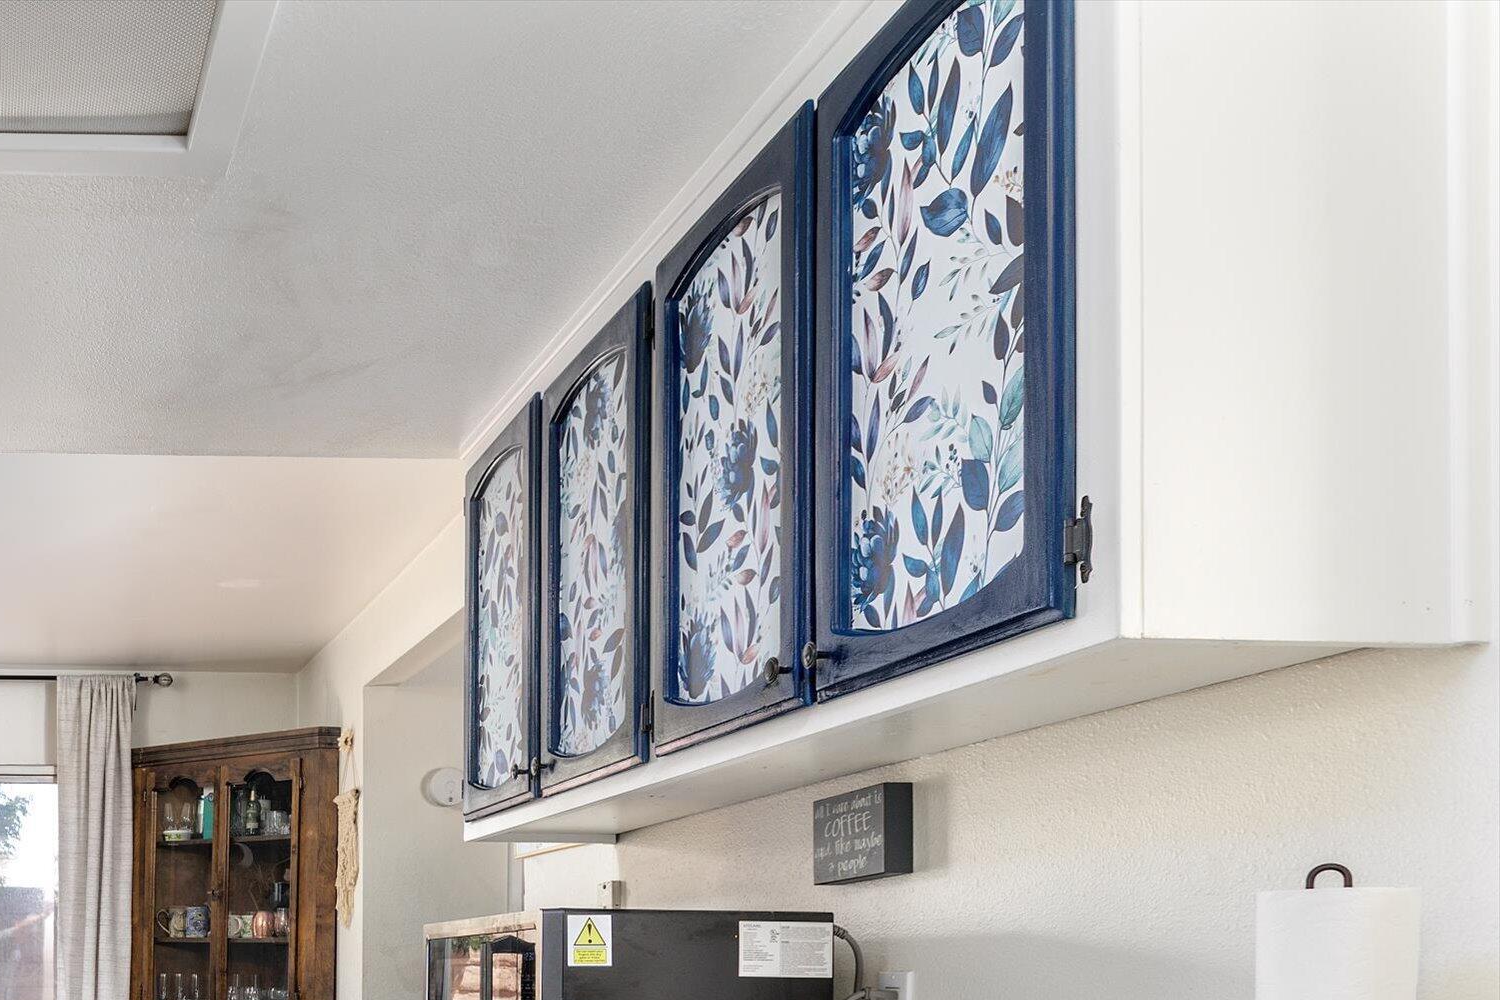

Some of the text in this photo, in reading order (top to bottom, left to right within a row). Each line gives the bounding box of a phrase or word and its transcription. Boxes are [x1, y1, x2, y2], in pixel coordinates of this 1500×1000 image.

[850, 793, 873, 810] about
[824, 810, 873, 838] COFFEE
[835, 837, 852, 856] like
[854, 830, 883, 851] maybe
[837, 853, 869, 877] people
